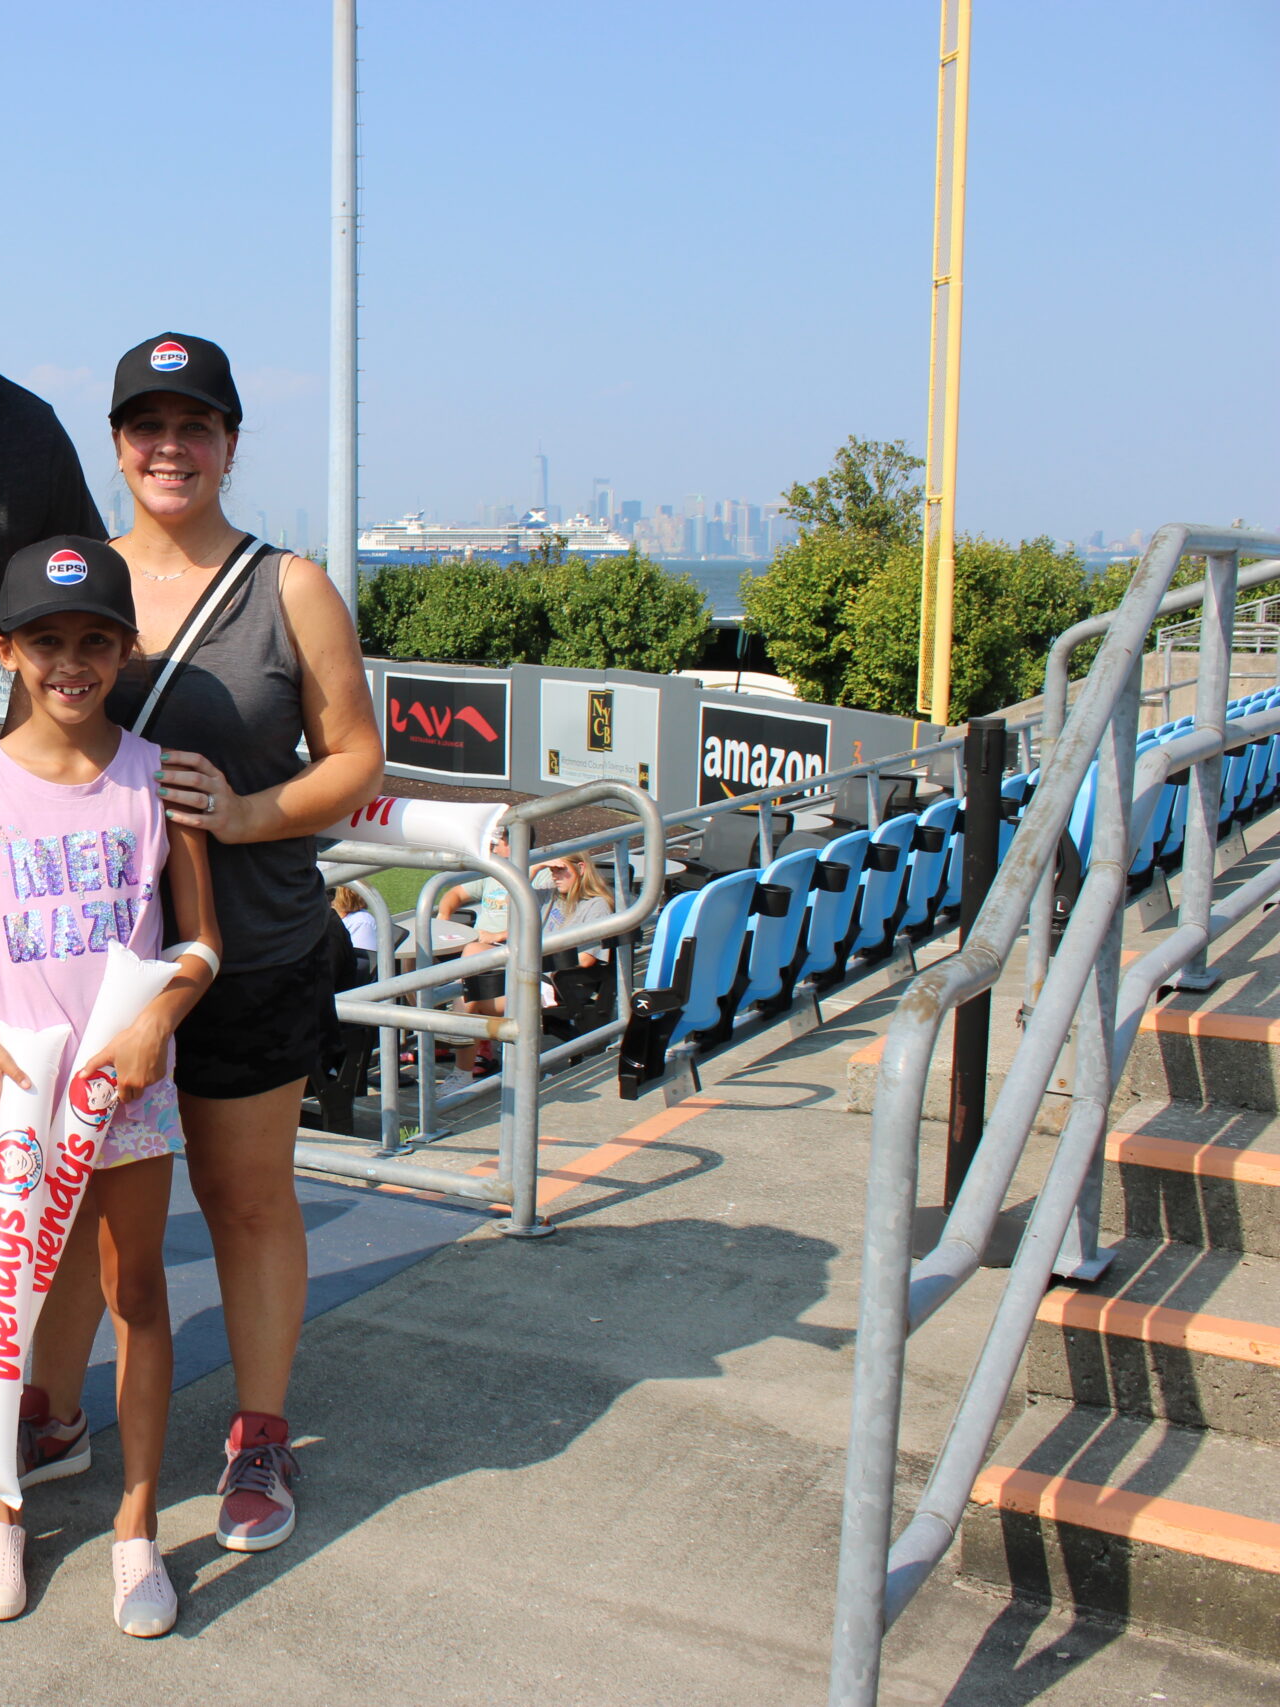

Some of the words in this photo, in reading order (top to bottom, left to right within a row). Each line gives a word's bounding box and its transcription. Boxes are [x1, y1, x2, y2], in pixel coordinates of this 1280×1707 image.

[152, 353, 187, 361] PEPSI
[48, 564, 86, 574] PEPSI
[703, 735, 823, 797] amazon
[1056, 901, 1066, 913] L
[636, 999, 649, 1010] K
[32, 1133, 95, 1293] Wendy's
